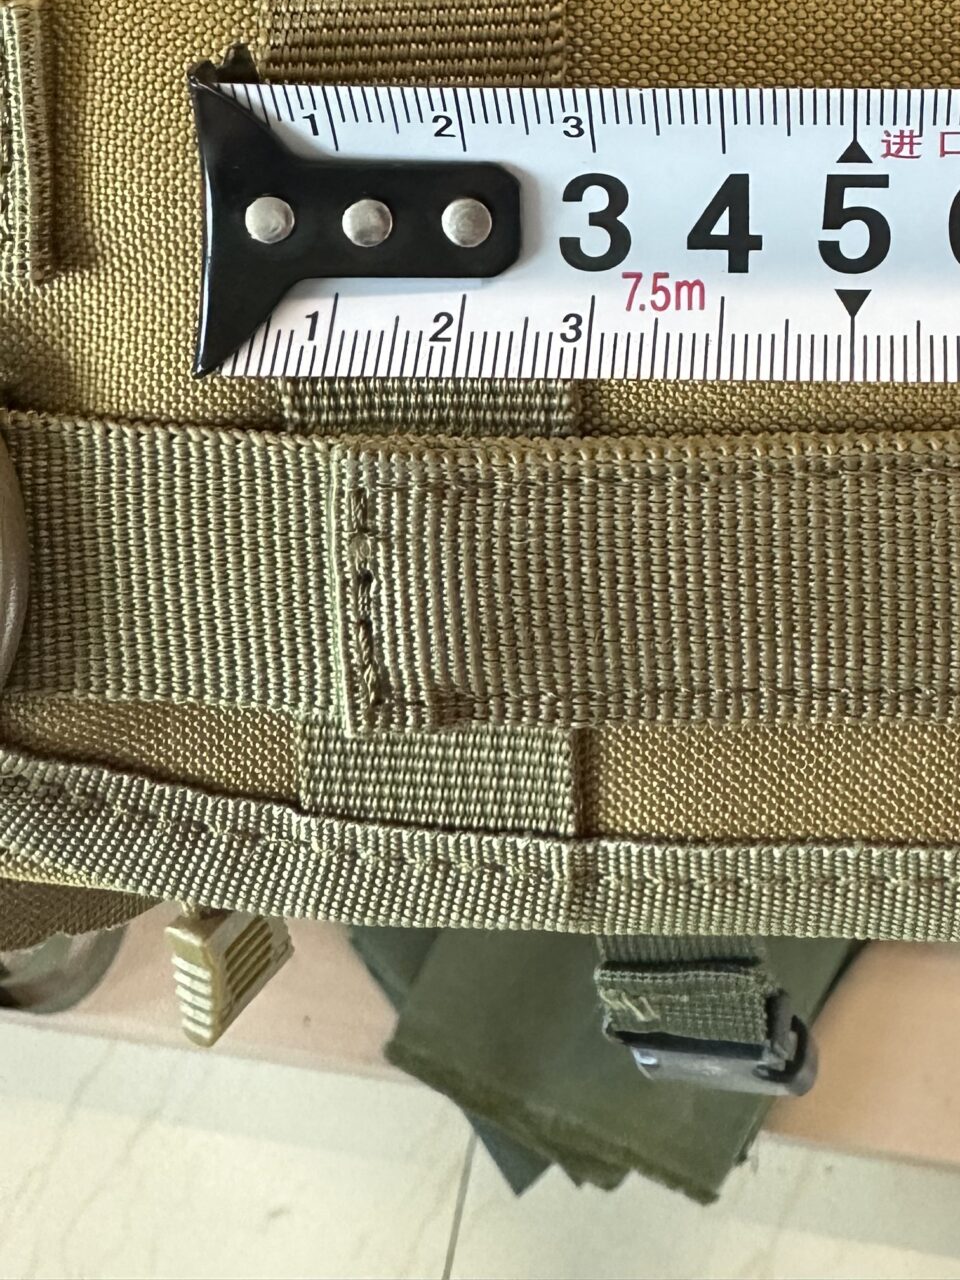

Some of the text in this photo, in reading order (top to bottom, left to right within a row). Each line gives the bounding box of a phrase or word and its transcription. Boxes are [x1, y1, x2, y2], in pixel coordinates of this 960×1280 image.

[302, 113, 585, 138] 1 2 3
[558, 173, 632, 272] 3
[687, 173, 763, 274] 4
[817, 174, 891, 274] 5
[621, 272, 705, 312] 7.5m
[305, 311, 583, 343] 1 2 3
